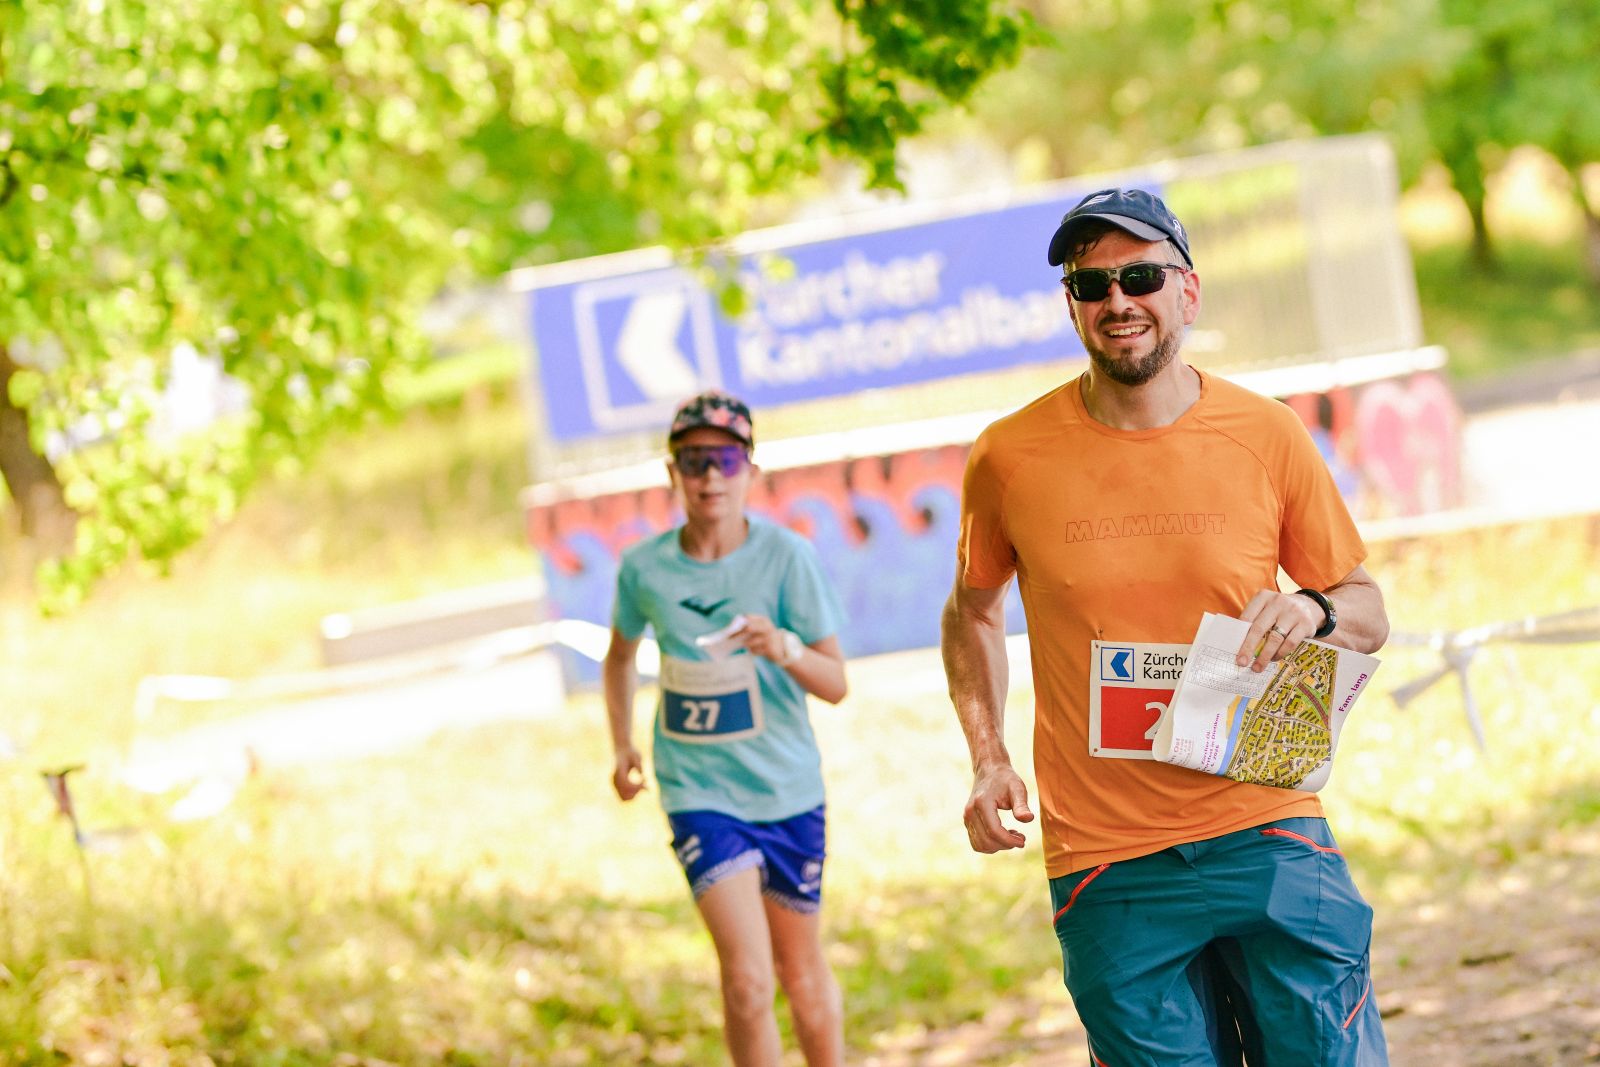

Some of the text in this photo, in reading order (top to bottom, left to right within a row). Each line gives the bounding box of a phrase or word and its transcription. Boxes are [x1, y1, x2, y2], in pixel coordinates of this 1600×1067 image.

[738, 284, 1067, 386] Kantonalba
[1065, 513, 1226, 544] MAMMUT
[1143, 652, 1187, 666] Zürch
[1143, 666, 1182, 680] Kant
[1338, 673, 1368, 712] Fam. lang
[682, 700, 720, 730] 27
